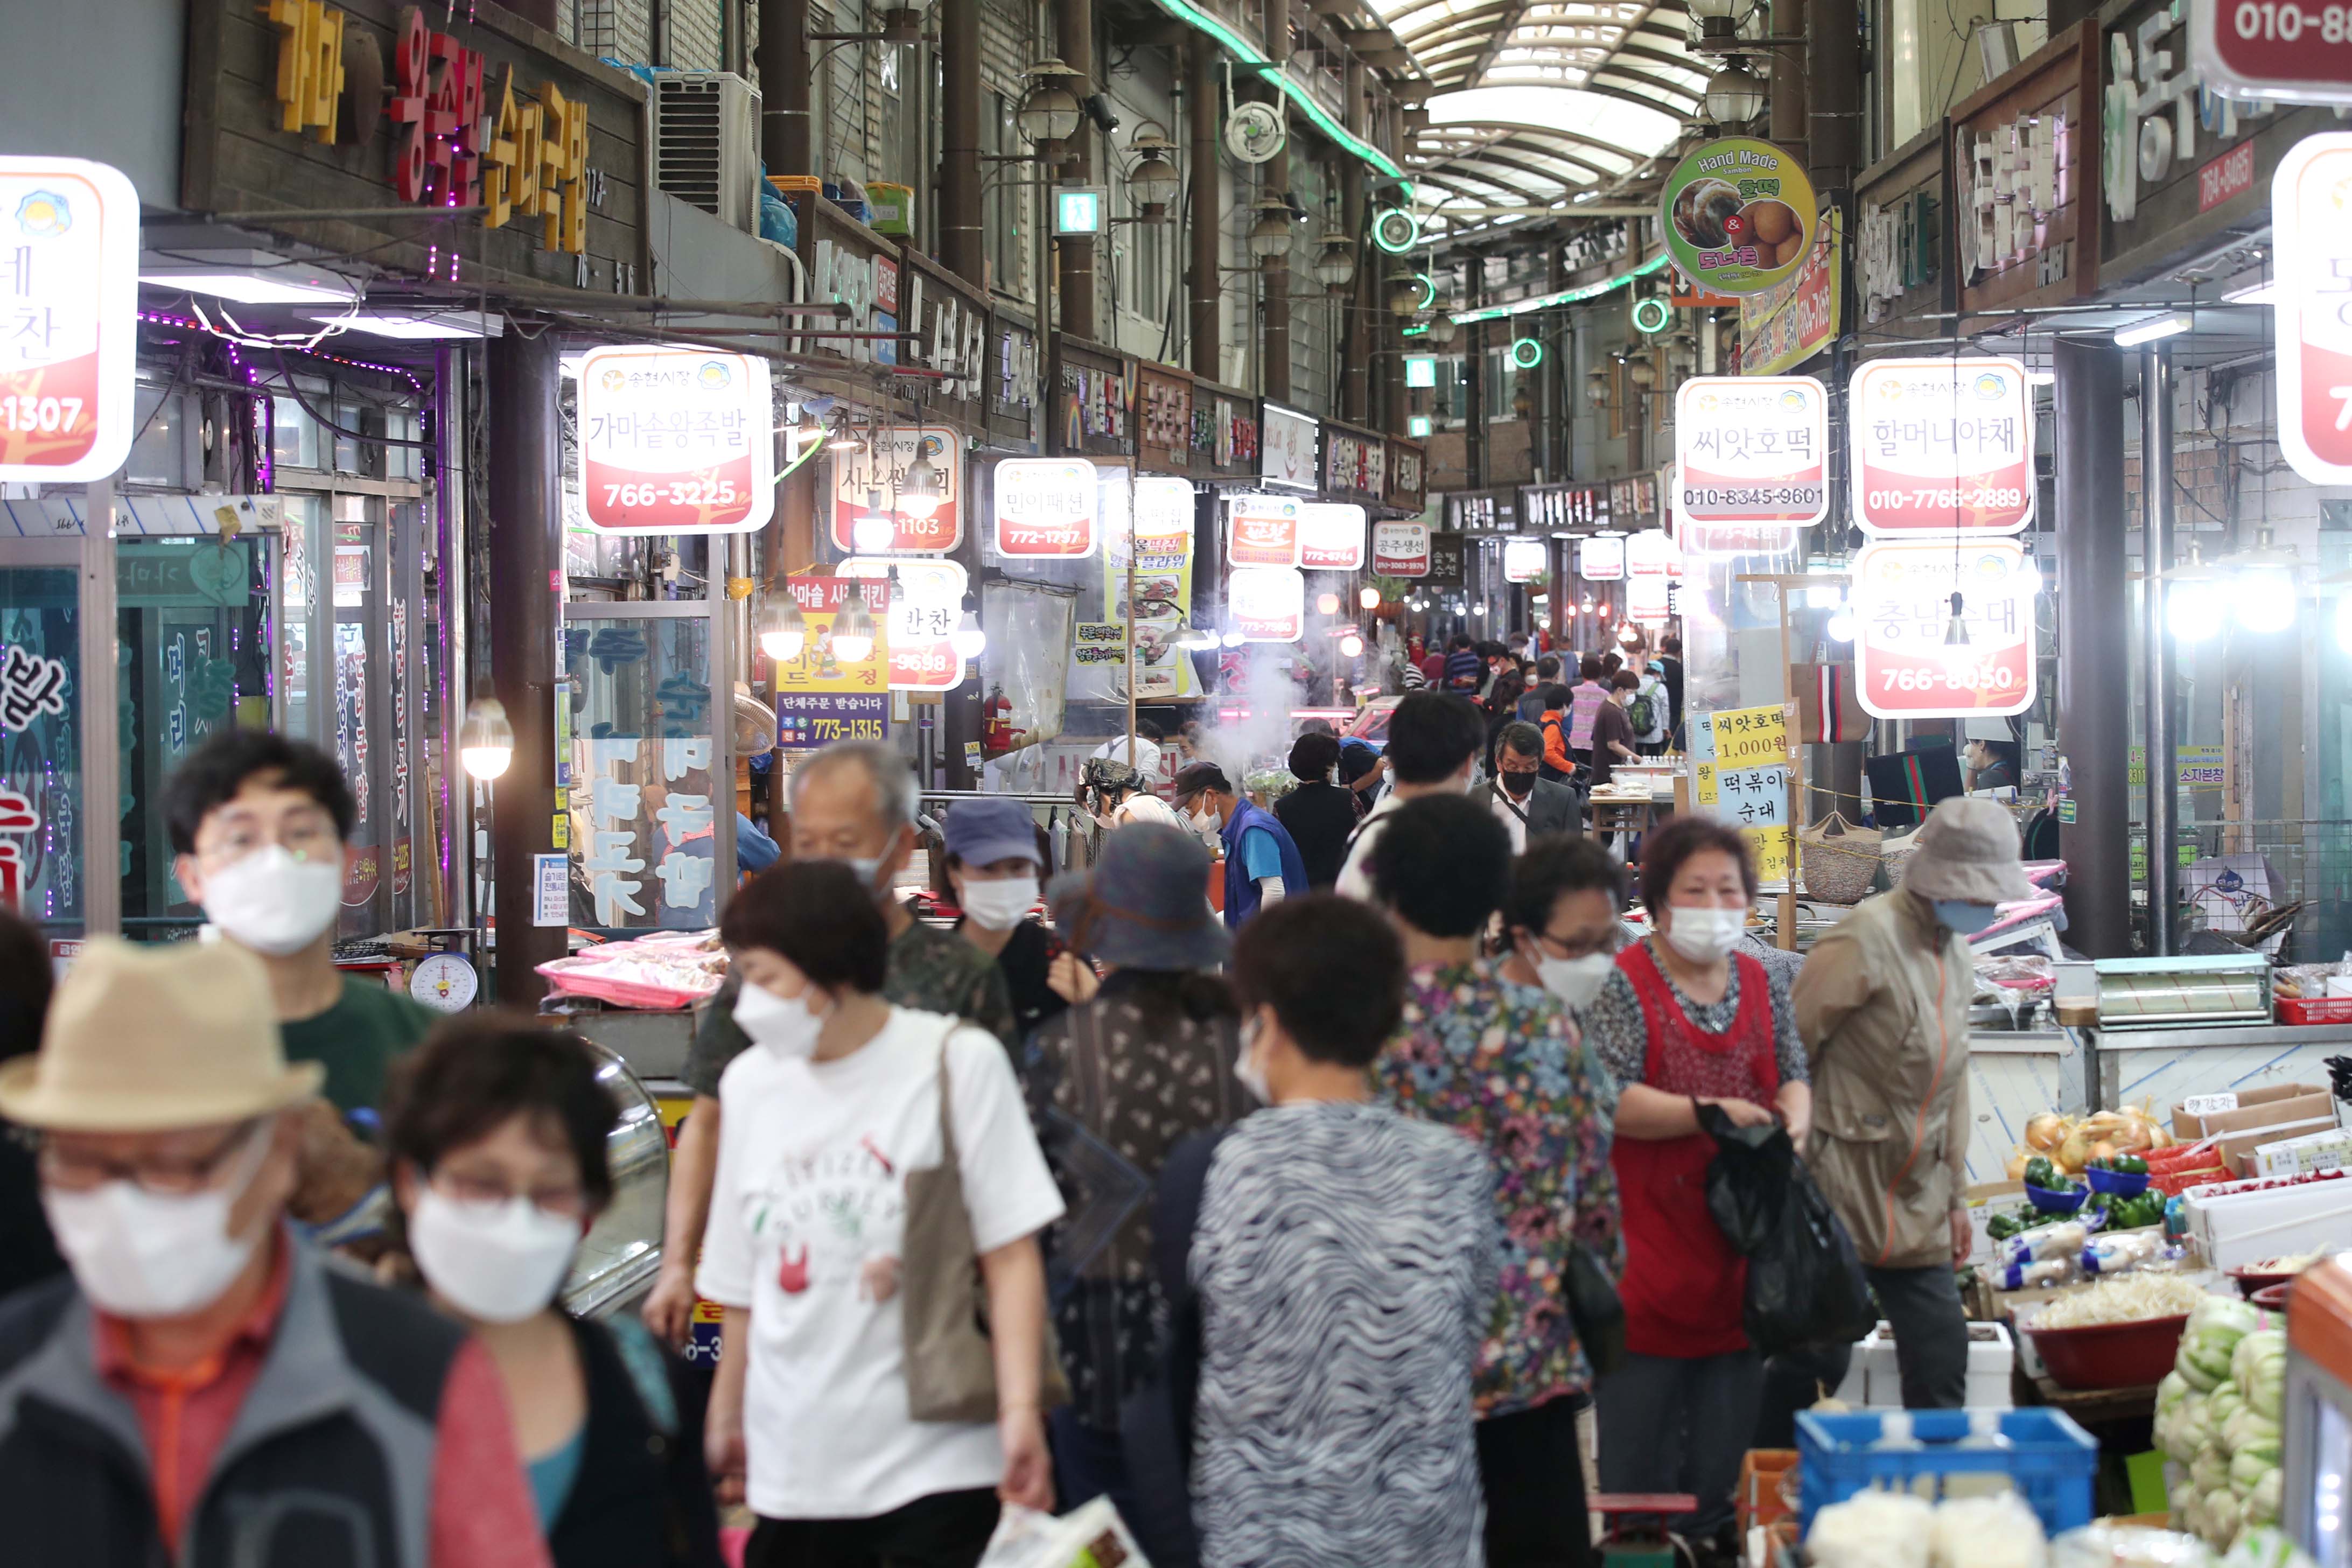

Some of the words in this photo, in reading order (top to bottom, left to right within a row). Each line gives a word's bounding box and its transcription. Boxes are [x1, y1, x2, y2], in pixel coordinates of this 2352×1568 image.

[2235, 2, 2352, 43] 010-8
[486, 62, 588, 254] 순대국밥
[1698, 151, 1734, 173] Hand
[1739, 150, 1777, 171] Made
[1723, 166, 1752, 175] Sambon
[1737, 178, 1780, 199] 호떡
[1698, 247, 1758, 270] 도너츠
[629, 370, 690, 387] 송현시장
[591, 409, 746, 449] 가마솥왕족발
[1873, 417, 2014, 456] 할머니야채
[873, 440, 915, 452] 현시장
[1693, 428, 1810, 460] 씨앗호떡
[604, 480, 735, 507] 766-3225
[1869, 488, 2021, 509] 010-7766-2889
[894, 519, 940, 535] -1103
[1009, 529, 1080, 543] 772-1797
[1378, 540, 1424, 553] 공주생선
[1142, 554, 1187, 570] 플라워
[831, 585, 884, 608] 시치킨
[888, 654, 946, 671] -9698
[783, 697, 830, 710] 단체주문
[836, 697, 883, 710] 받습니다
[813, 719, 883, 741] 773-1315
[1717, 710, 1785, 734] 씨앗호떡
[1721, 735, 1787, 759] 1,000원
[1724, 771, 1783, 795] 떡볶이
[2179, 767, 2224, 783] 소자본창
[1737, 800, 1775, 823] 순대
